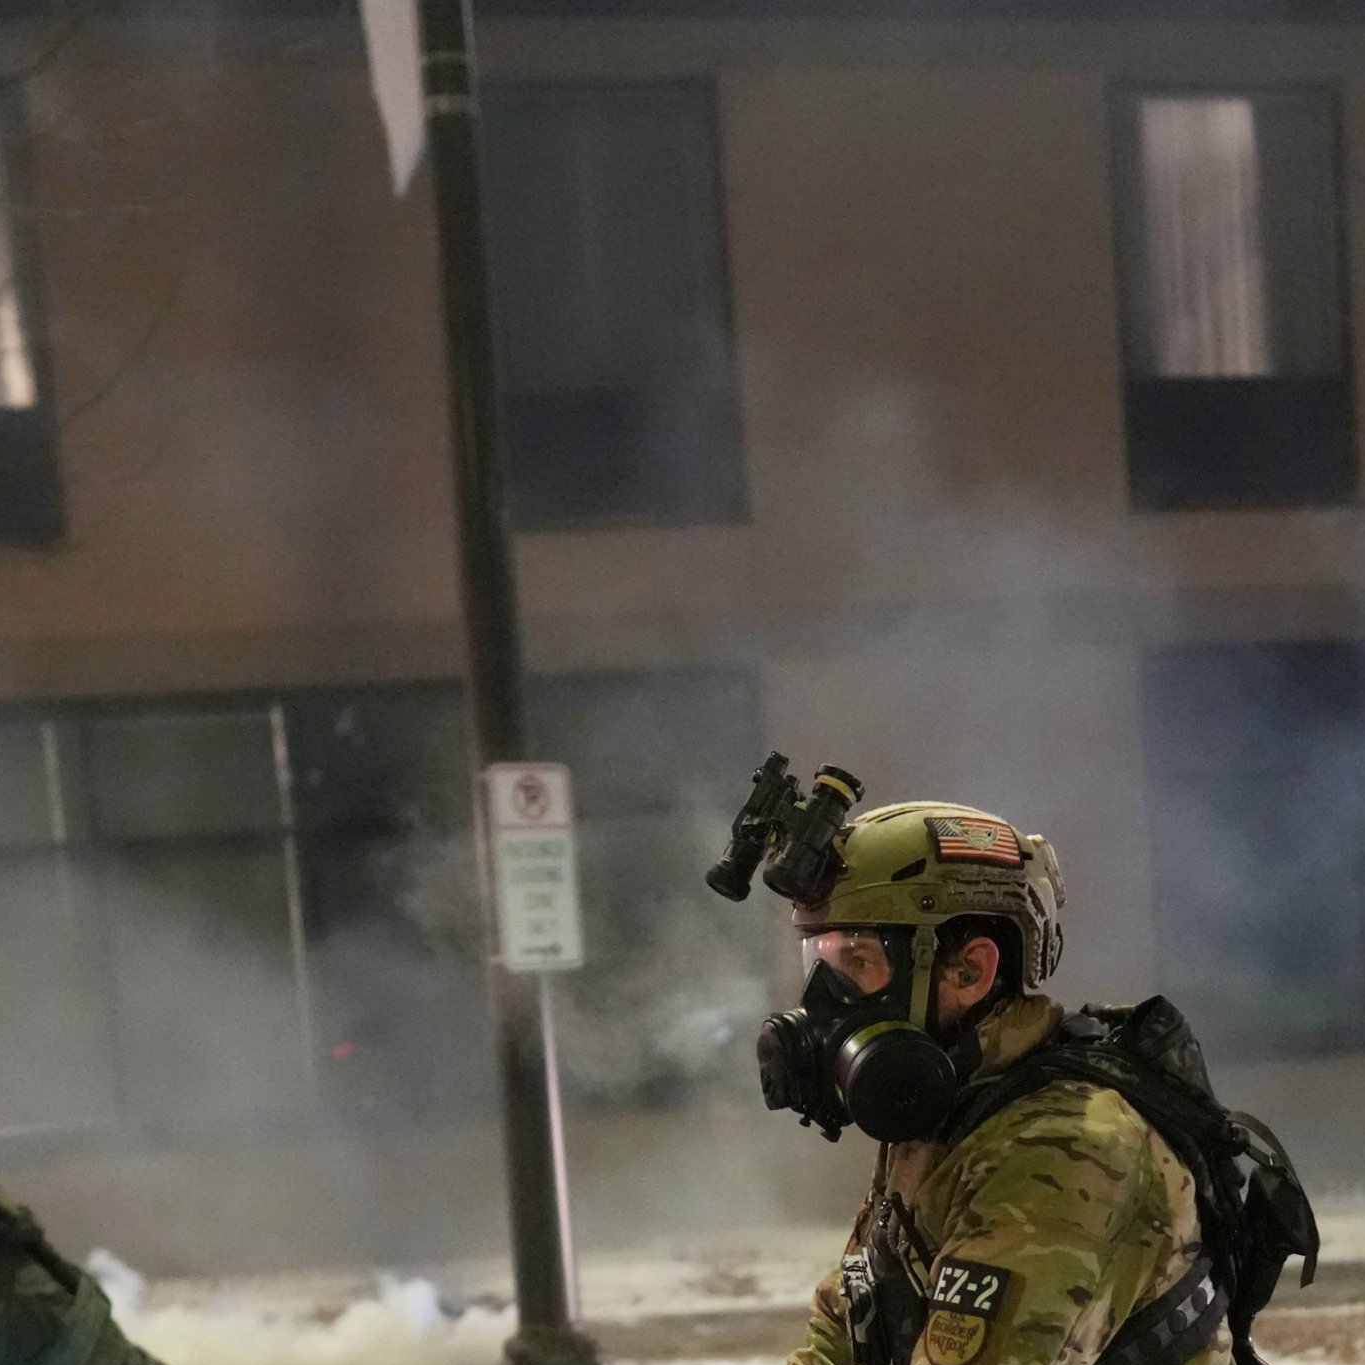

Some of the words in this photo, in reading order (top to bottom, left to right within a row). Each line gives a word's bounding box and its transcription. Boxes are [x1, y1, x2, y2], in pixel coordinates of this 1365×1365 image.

[933, 1266, 999, 1310] EZ-2
[933, 1321, 974, 1339] BORDER
[930, 1334, 966, 1352] PATROL
